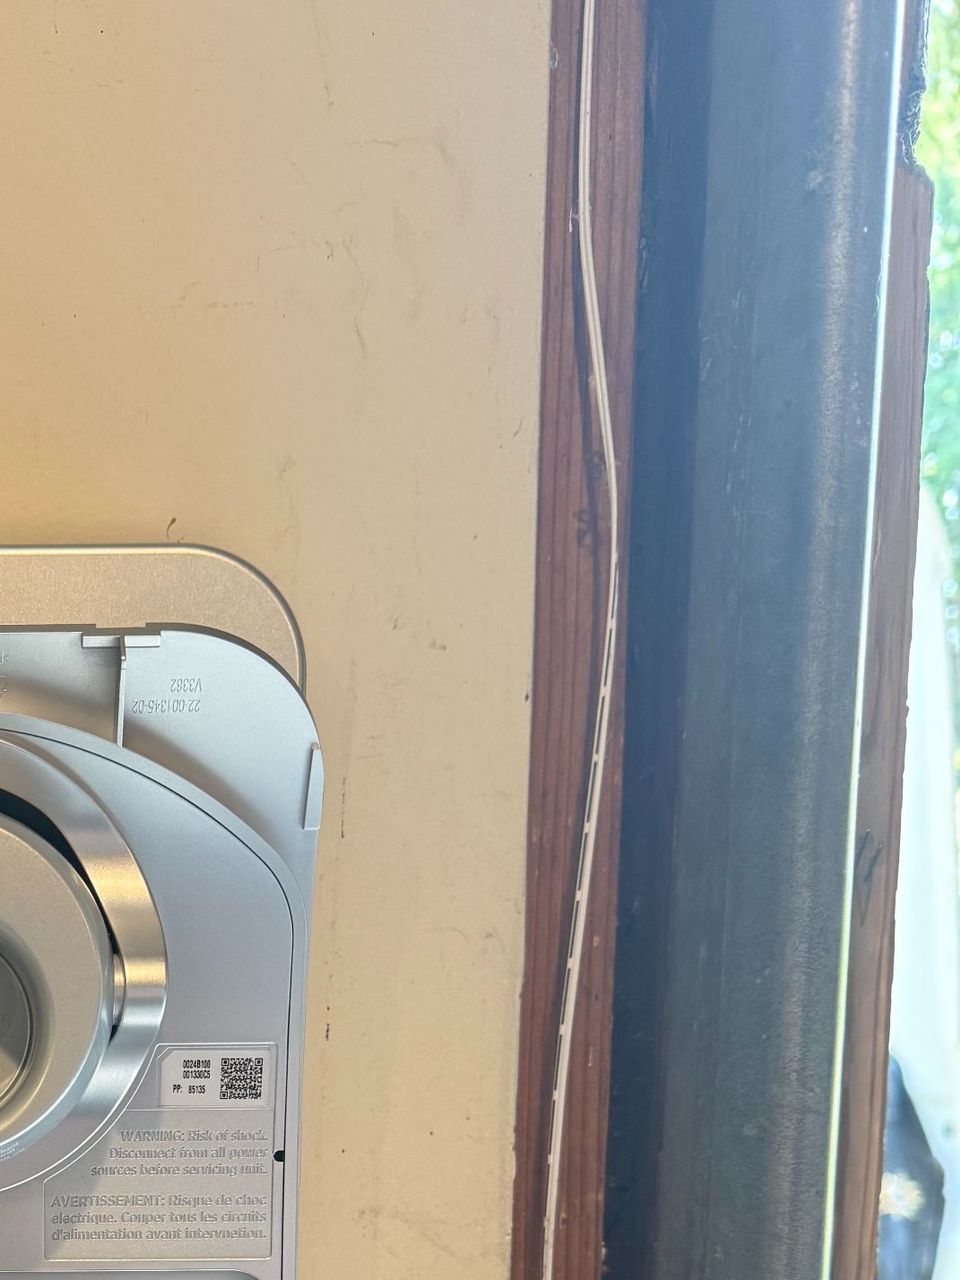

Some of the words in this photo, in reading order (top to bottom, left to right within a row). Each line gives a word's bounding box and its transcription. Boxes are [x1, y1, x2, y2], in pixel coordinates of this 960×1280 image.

[172, 1084, 183, 1094] PP:
[120, 1130, 185, 1142] WARNING:
[188, 1130, 212, 1142] Risk
[215, 1130, 228, 1142] of
[109, 1147, 176, 1159] Disconnect
[179, 1147, 208, 1159] from
[211, 1147, 226, 1159] all
[228, 1147, 268, 1159] power
[90, 1165, 137, 1176] sources
[140, 1164, 179, 1175] before
[182, 1164, 237, 1176] servicing
[50, 1195, 165, 1208] AVERTISSEMENT:
[168, 1194, 212, 1208] Risque
[215, 1194, 231, 1206] de
[235, 1194, 267, 1206] choc
[121, 1211, 166, 1225] Couper
[170, 1211, 197, 1224] tous
[200, 1211, 218, 1223] les
[220, 1211, 267, 1223] circuits
[146, 1228, 181, 1241] avant
